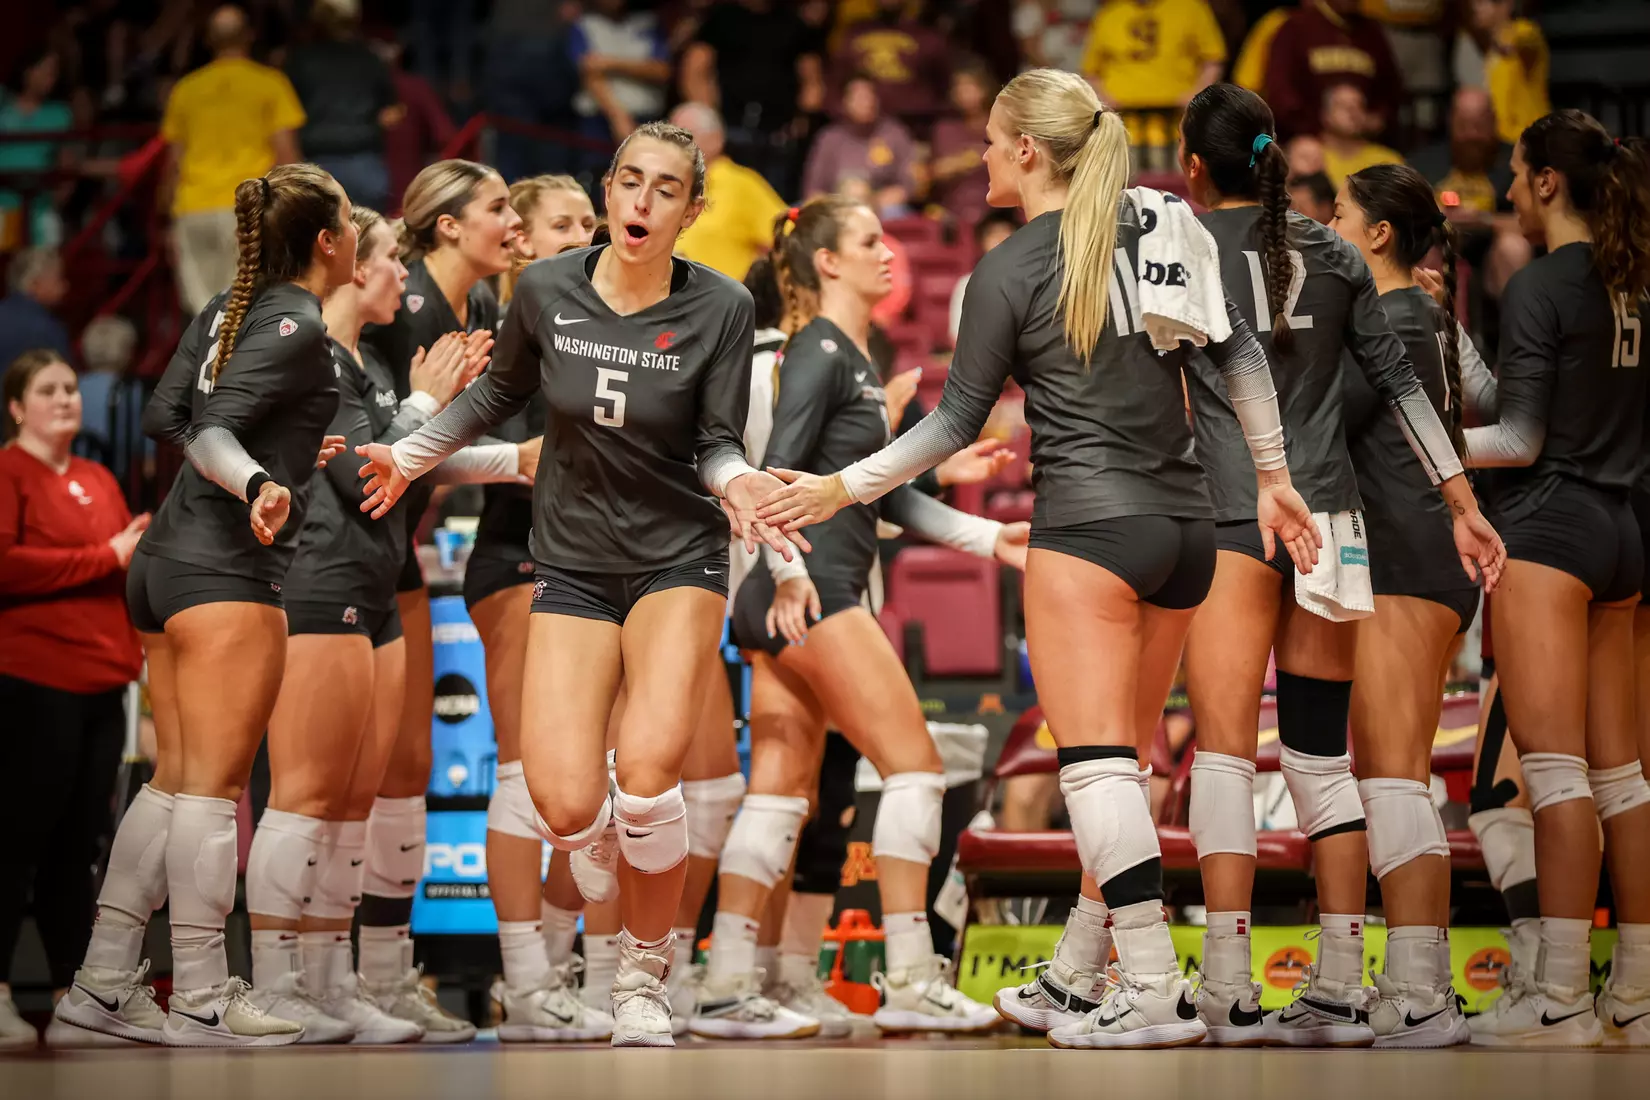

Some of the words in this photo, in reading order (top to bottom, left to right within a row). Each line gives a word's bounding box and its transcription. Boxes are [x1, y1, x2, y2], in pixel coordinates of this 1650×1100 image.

[1241, 250, 1314, 332] 12
[554, 333, 638, 366] WASHINGTON
[641, 351, 680, 372] STATE
[1611, 291, 1641, 368] 15
[593, 366, 629, 428] 5
